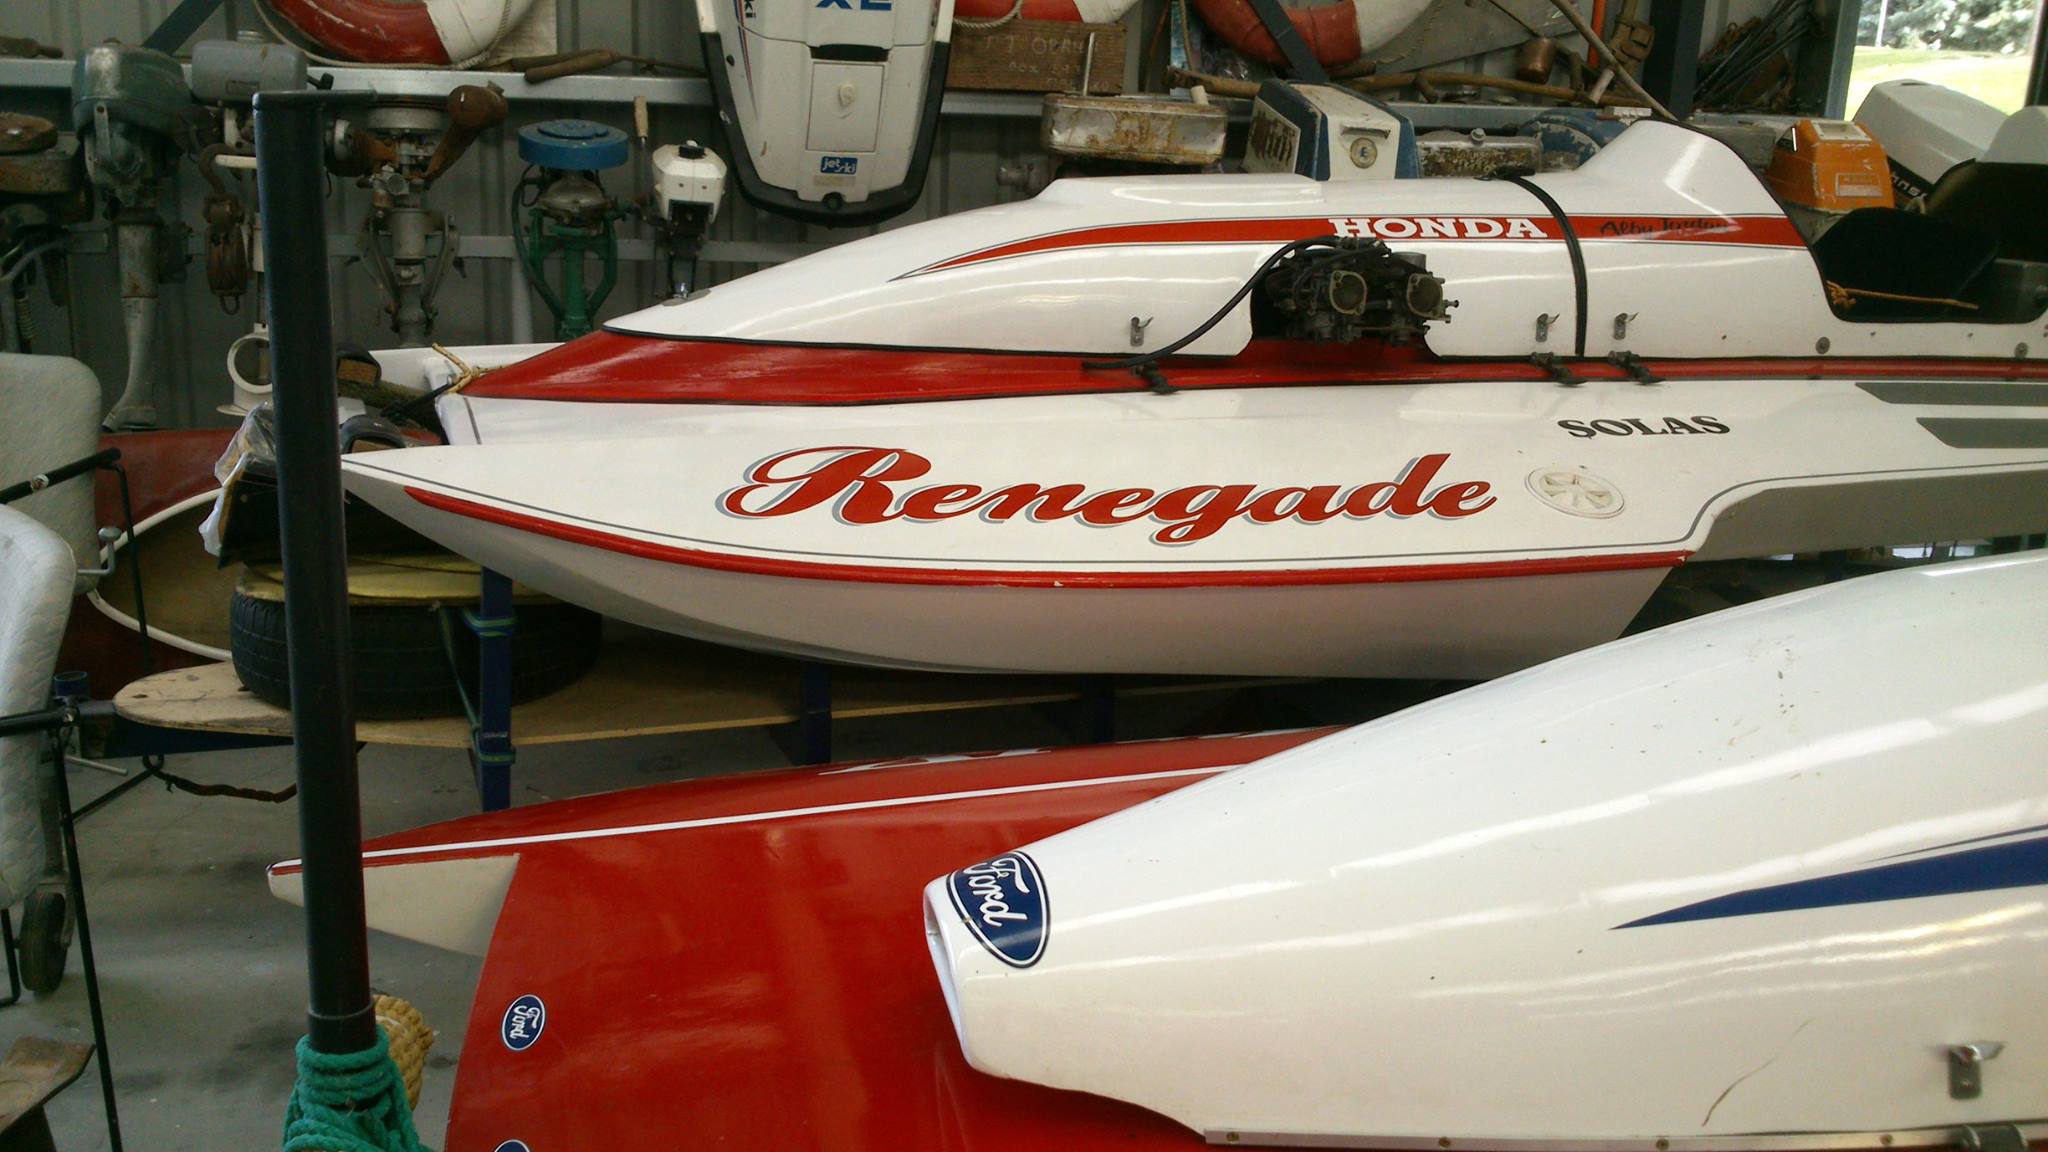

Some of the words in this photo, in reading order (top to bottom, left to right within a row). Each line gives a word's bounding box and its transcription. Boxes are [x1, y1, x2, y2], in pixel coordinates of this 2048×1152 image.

[1328, 217, 1548, 239] HONDA
[1557, 415, 1731, 439] SOLAS
[714, 445, 1498, 547] Renegade
[963, 857, 1030, 927] Ford
[510, 1005, 541, 1039] Ford
